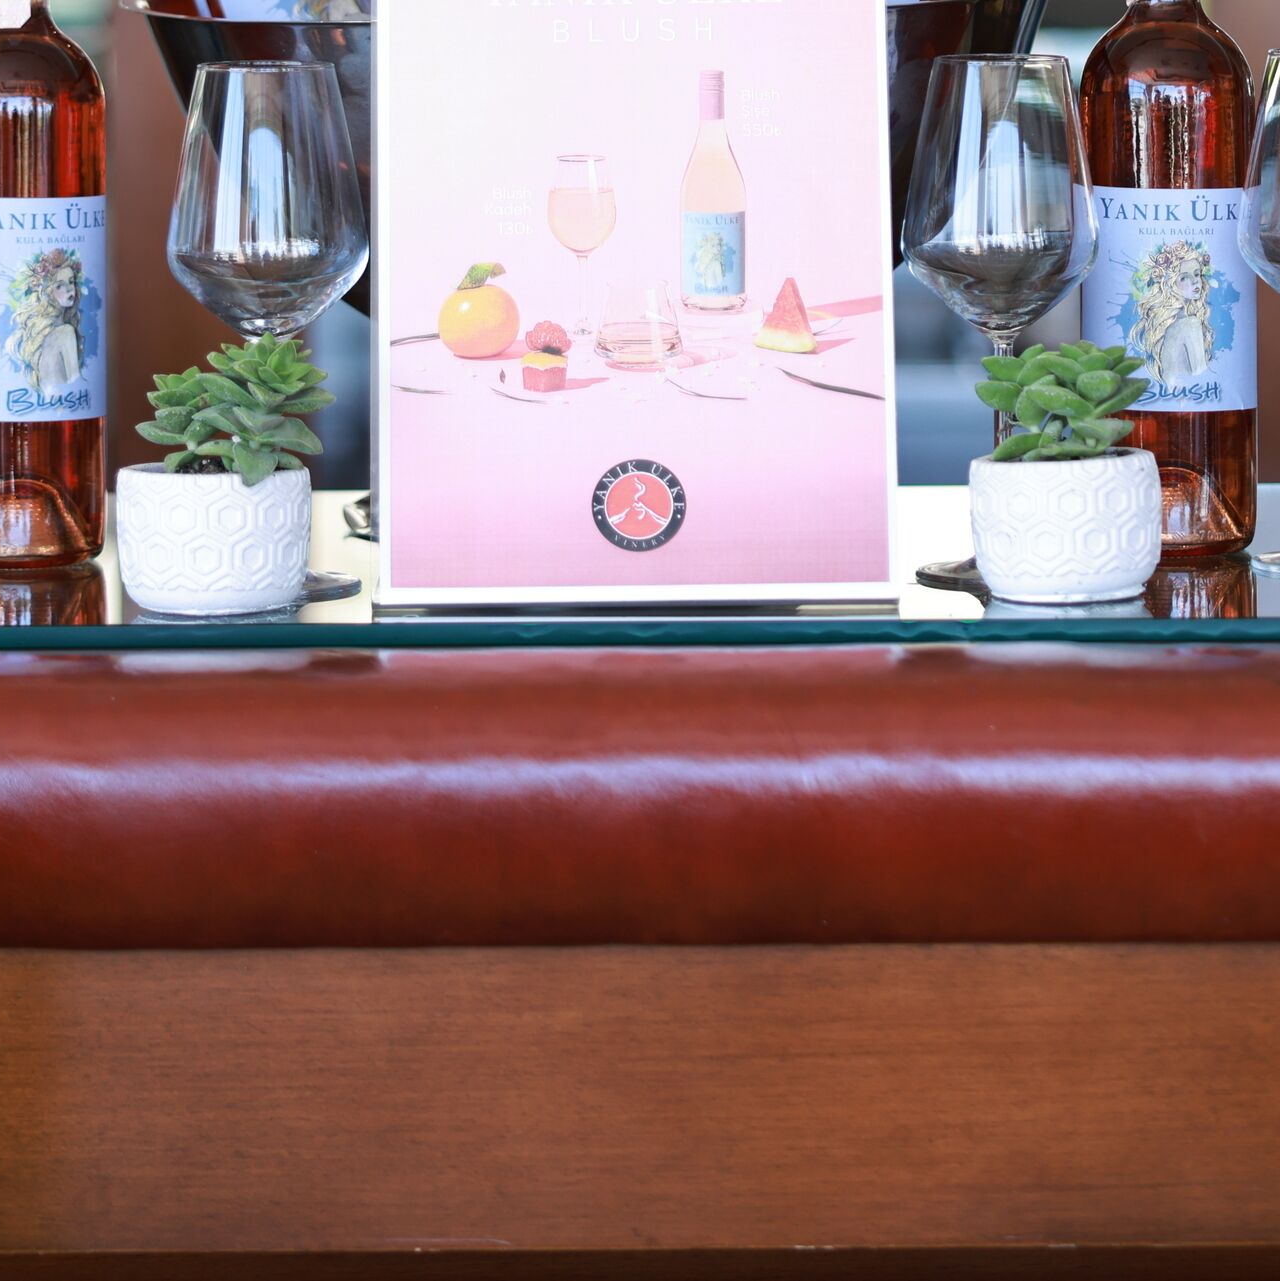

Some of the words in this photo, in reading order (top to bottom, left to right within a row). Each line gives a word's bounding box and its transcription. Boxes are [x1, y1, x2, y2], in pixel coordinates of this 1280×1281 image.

[553, 16, 713, 44] BLUSH
[740, 88, 782, 102] Blush
[491, 186, 532, 200] Blush
[1100, 197, 1182, 221] YANIK
[1138, 227, 1166, 236] KULA
[1170, 225, 1214, 236] BAĞLARI
[592, 461, 638, 512] YANIK
[651, 462, 685, 511] ÜLKE
